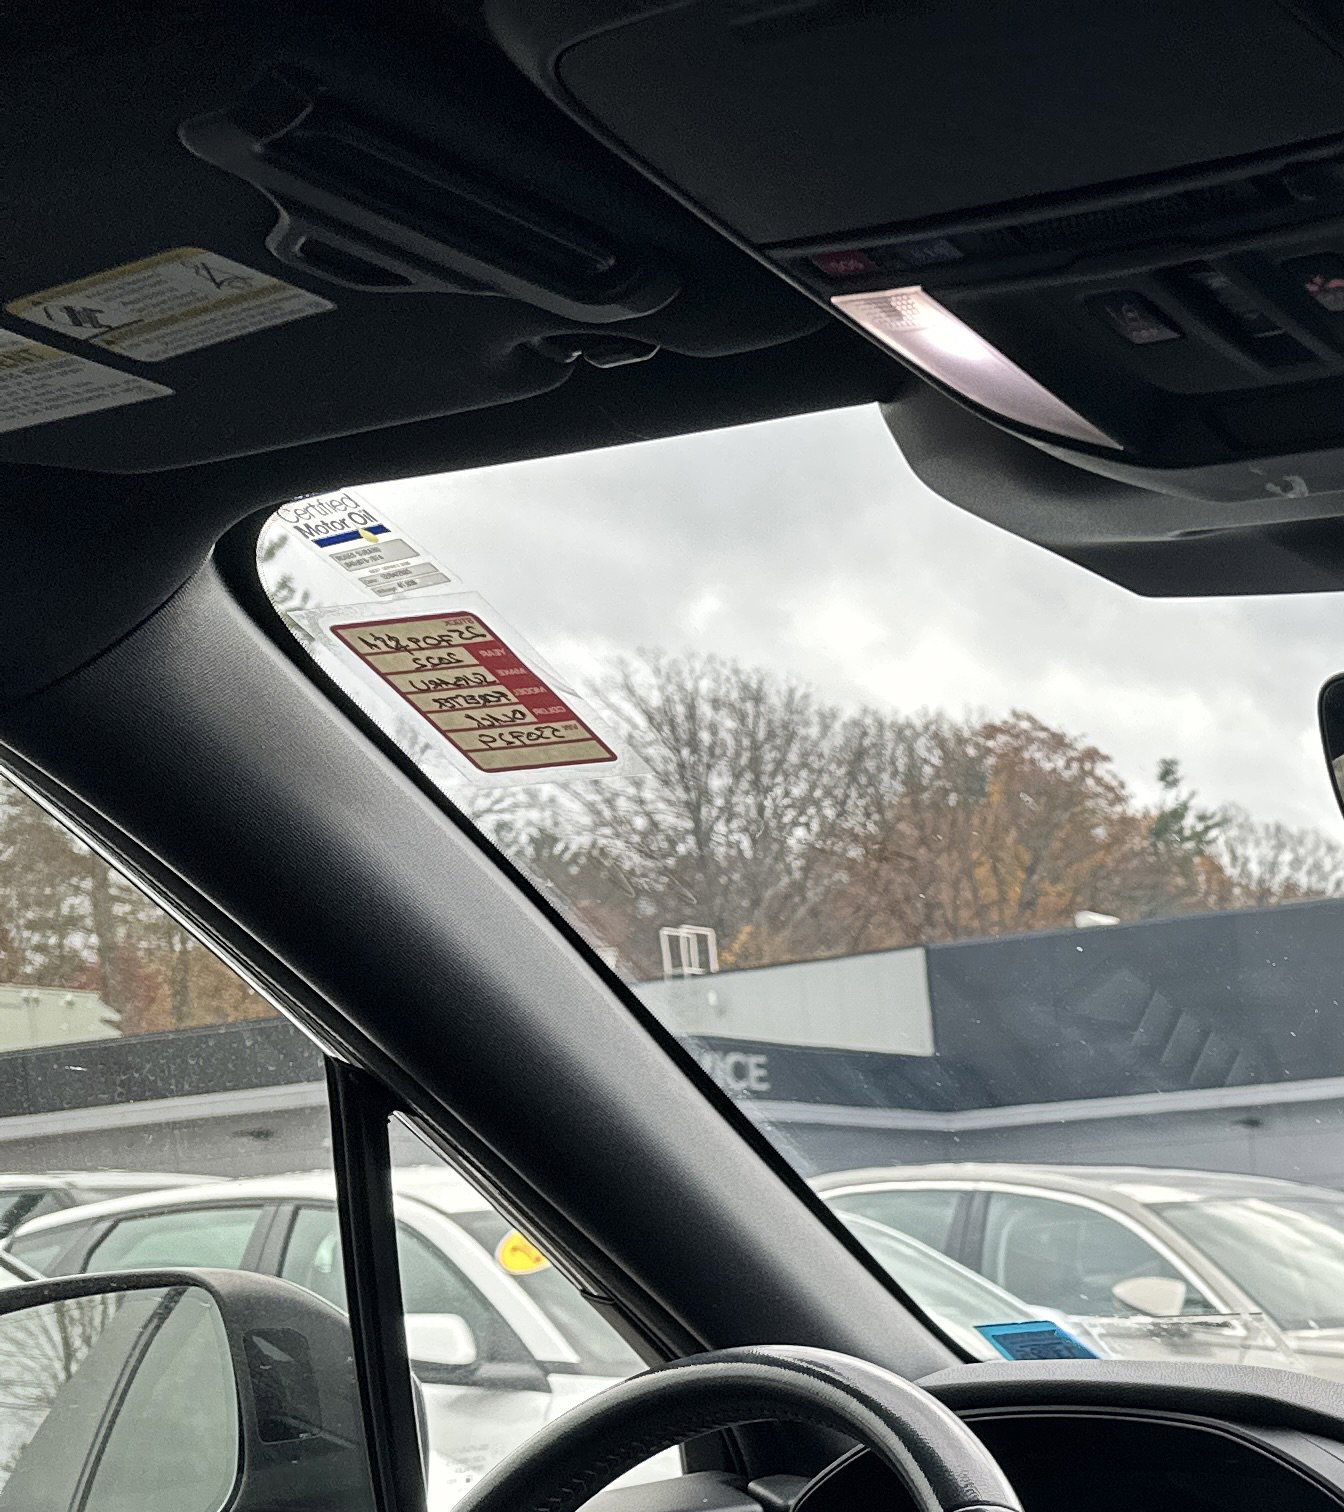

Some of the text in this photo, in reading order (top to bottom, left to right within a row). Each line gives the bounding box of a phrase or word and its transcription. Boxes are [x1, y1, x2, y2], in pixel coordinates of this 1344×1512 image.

[277, 493, 360, 524] Certified
[294, 509, 378, 539] Motor Oil
